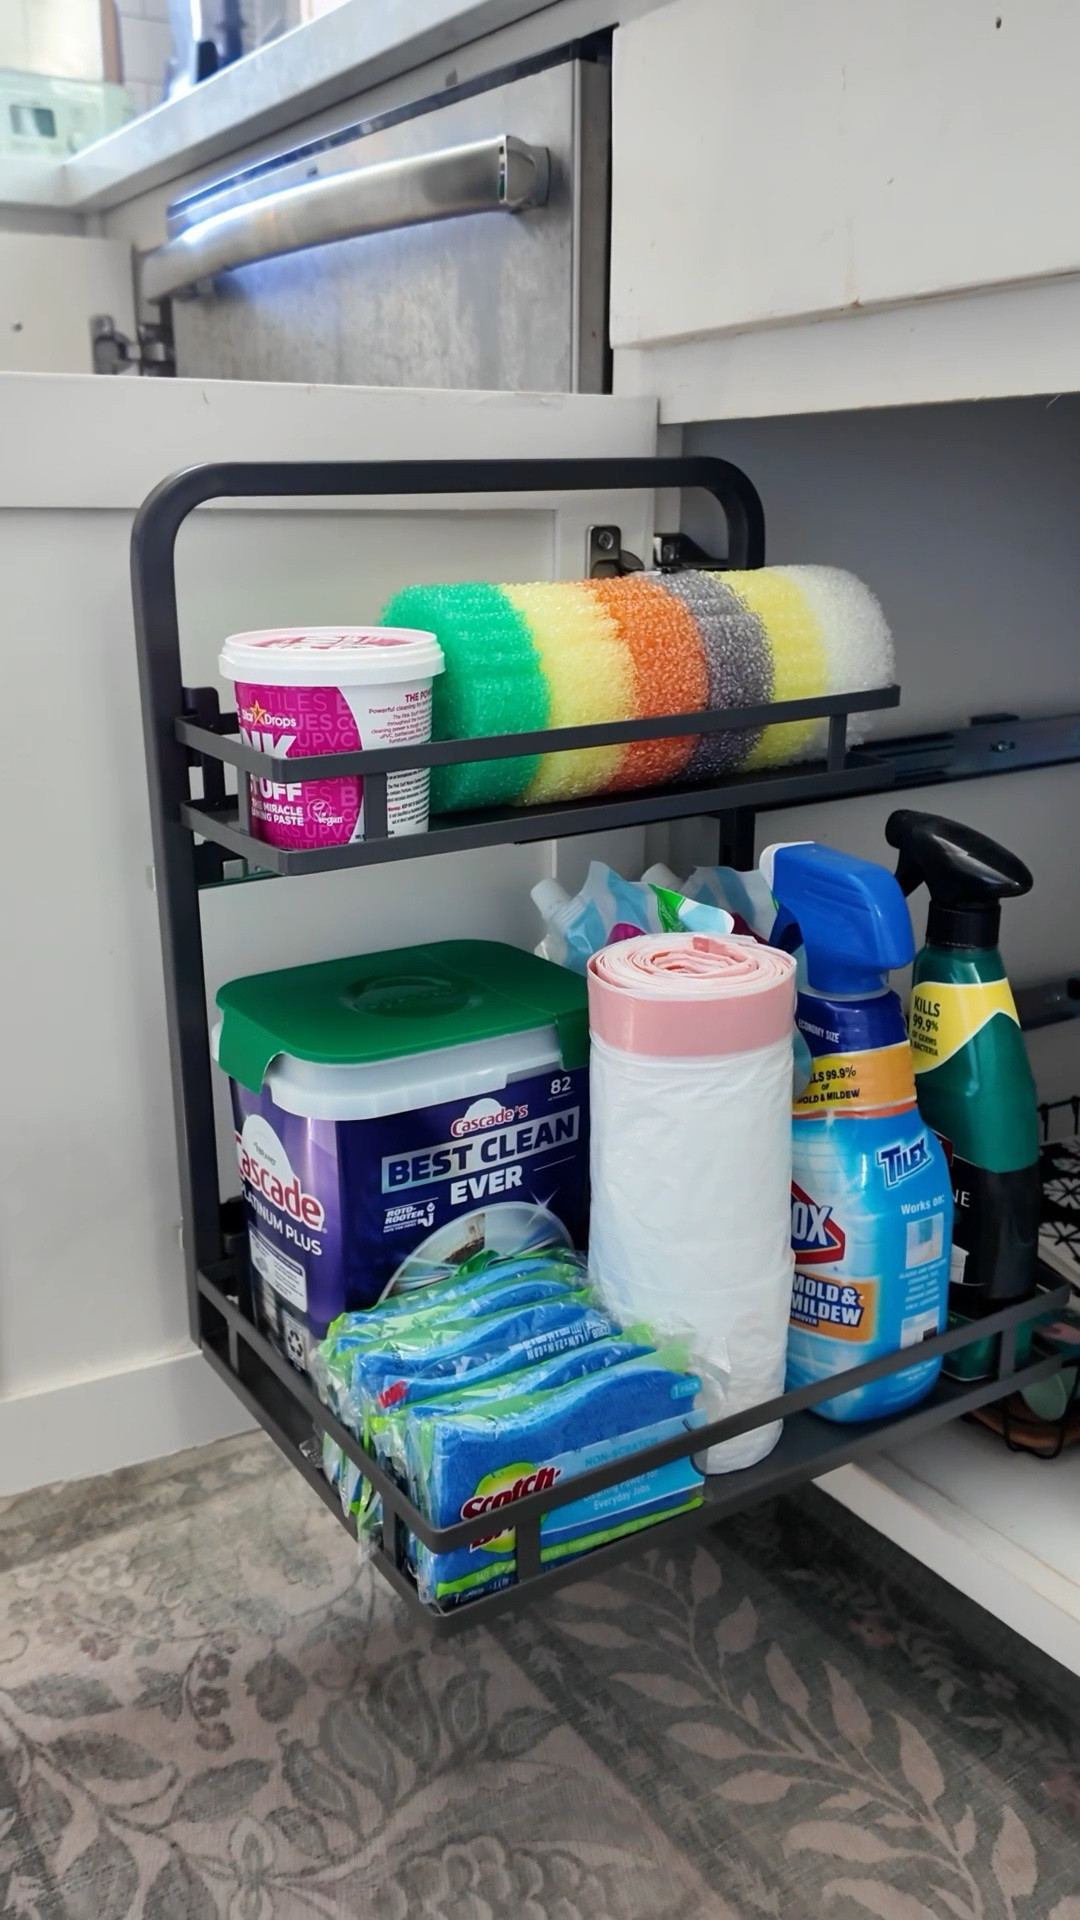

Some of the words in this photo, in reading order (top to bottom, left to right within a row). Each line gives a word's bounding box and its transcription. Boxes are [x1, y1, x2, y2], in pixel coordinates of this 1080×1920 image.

[405, 692, 419, 703] THE
[368, 706, 395, 714] Powerful
[264, 714, 297, 729] Drops
[263, 803, 303, 817] MIRACLE
[273, 815, 304, 827] PASTE
[914, 995, 940, 1018] KILLS
[798, 1018, 824, 1038] ECONOMY
[825, 1030, 840, 1044] SIZE
[913, 1013, 939, 1032] 99.9%
[913, 1040, 938, 1056] BACTERIA
[918, 1033, 937, 1047] GERMS
[825, 1065, 857, 1081] 99.9%
[550, 1076, 572, 1095] 82
[820, 1093, 826, 1102] &
[826, 1088, 861, 1101] MILDEW
[821, 1082, 830, 1091] OF
[451, 1104, 528, 1137] Cascade's
[388, 1143, 474, 1187] BEST
[480, 1112, 576, 1163] CLEAN
[235, 1134, 325, 1231] ascade
[450, 1165, 523, 1206] EVER
[386, 1205, 417, 1218] ROTO-
[901, 1199, 931, 1216] Works
[932, 1195, 945, 1206] on:
[385, 1209, 424, 1225] ROOTER
[285, 1224, 322, 1256] PLUS
[792, 1274, 839, 1302] MOLD
[841, 1286, 859, 1306] &
[791, 1291, 862, 1327] MILDEW
[673, 1384, 679, 1398] 1
[680, 1381, 700, 1394] PACK
[585, 1437, 658, 1467] NON-SCRATCH
[593, 1489, 632, 1512] Everyday
[632, 1484, 650, 1498] Jobs
